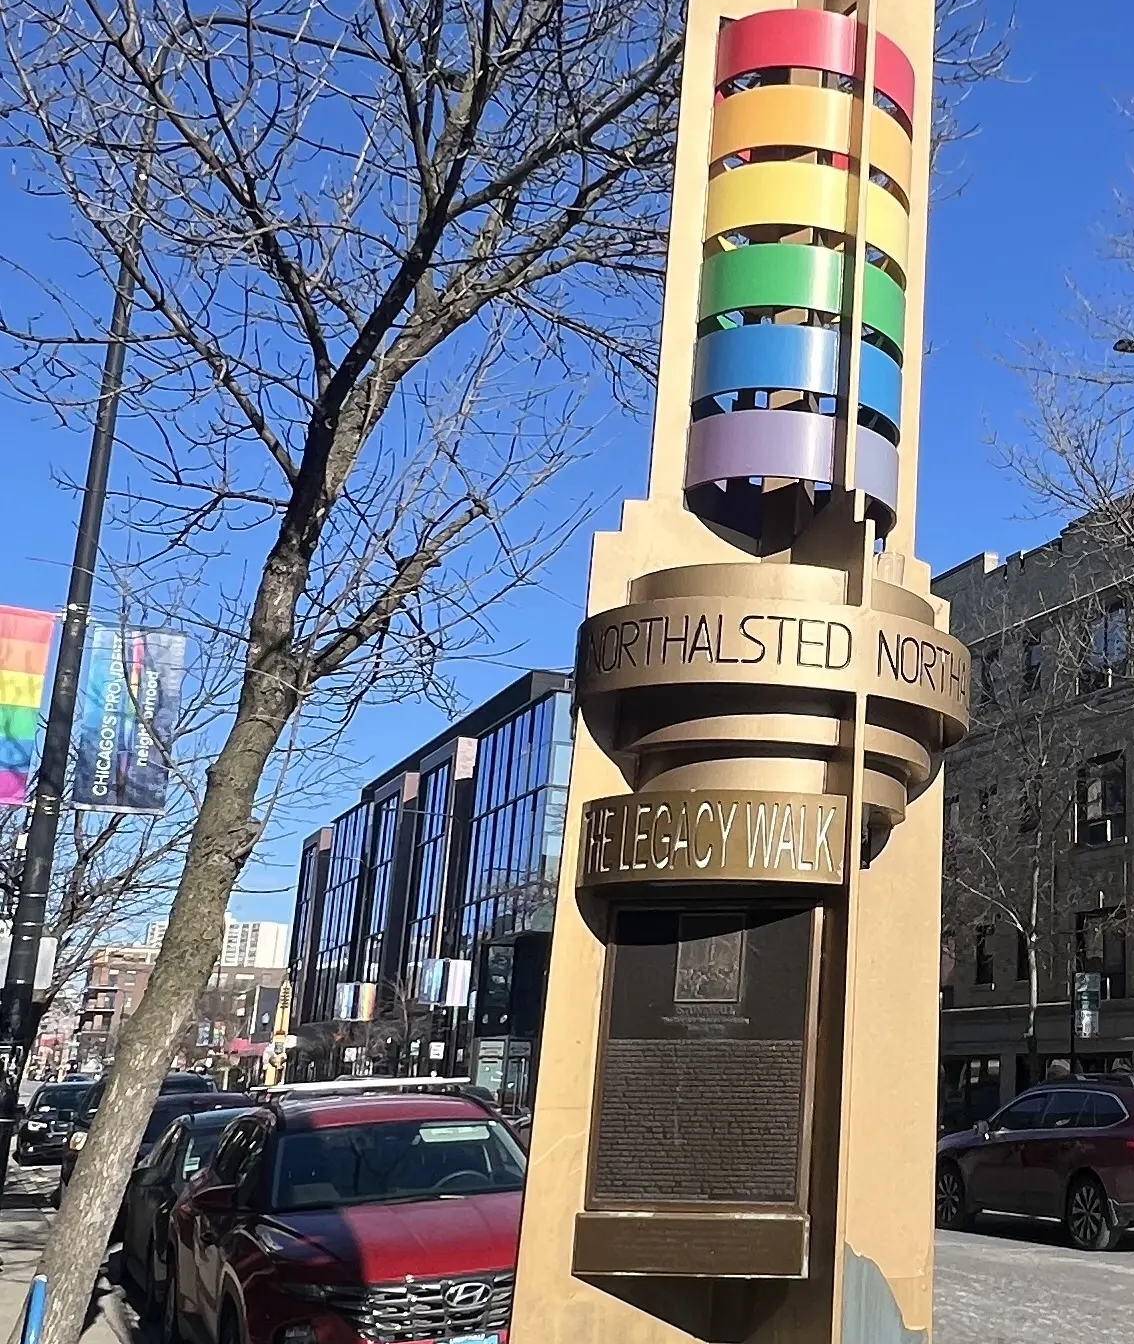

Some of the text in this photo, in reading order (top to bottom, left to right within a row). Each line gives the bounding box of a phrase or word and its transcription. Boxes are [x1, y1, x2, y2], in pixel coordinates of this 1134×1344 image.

[587, 613, 853, 674] NORTHALSTED
[92, 715, 117, 796] CHICAGO'S
[136, 670, 159, 767] neighorhood
[585, 800, 836, 873] THE LEGACY WALK
